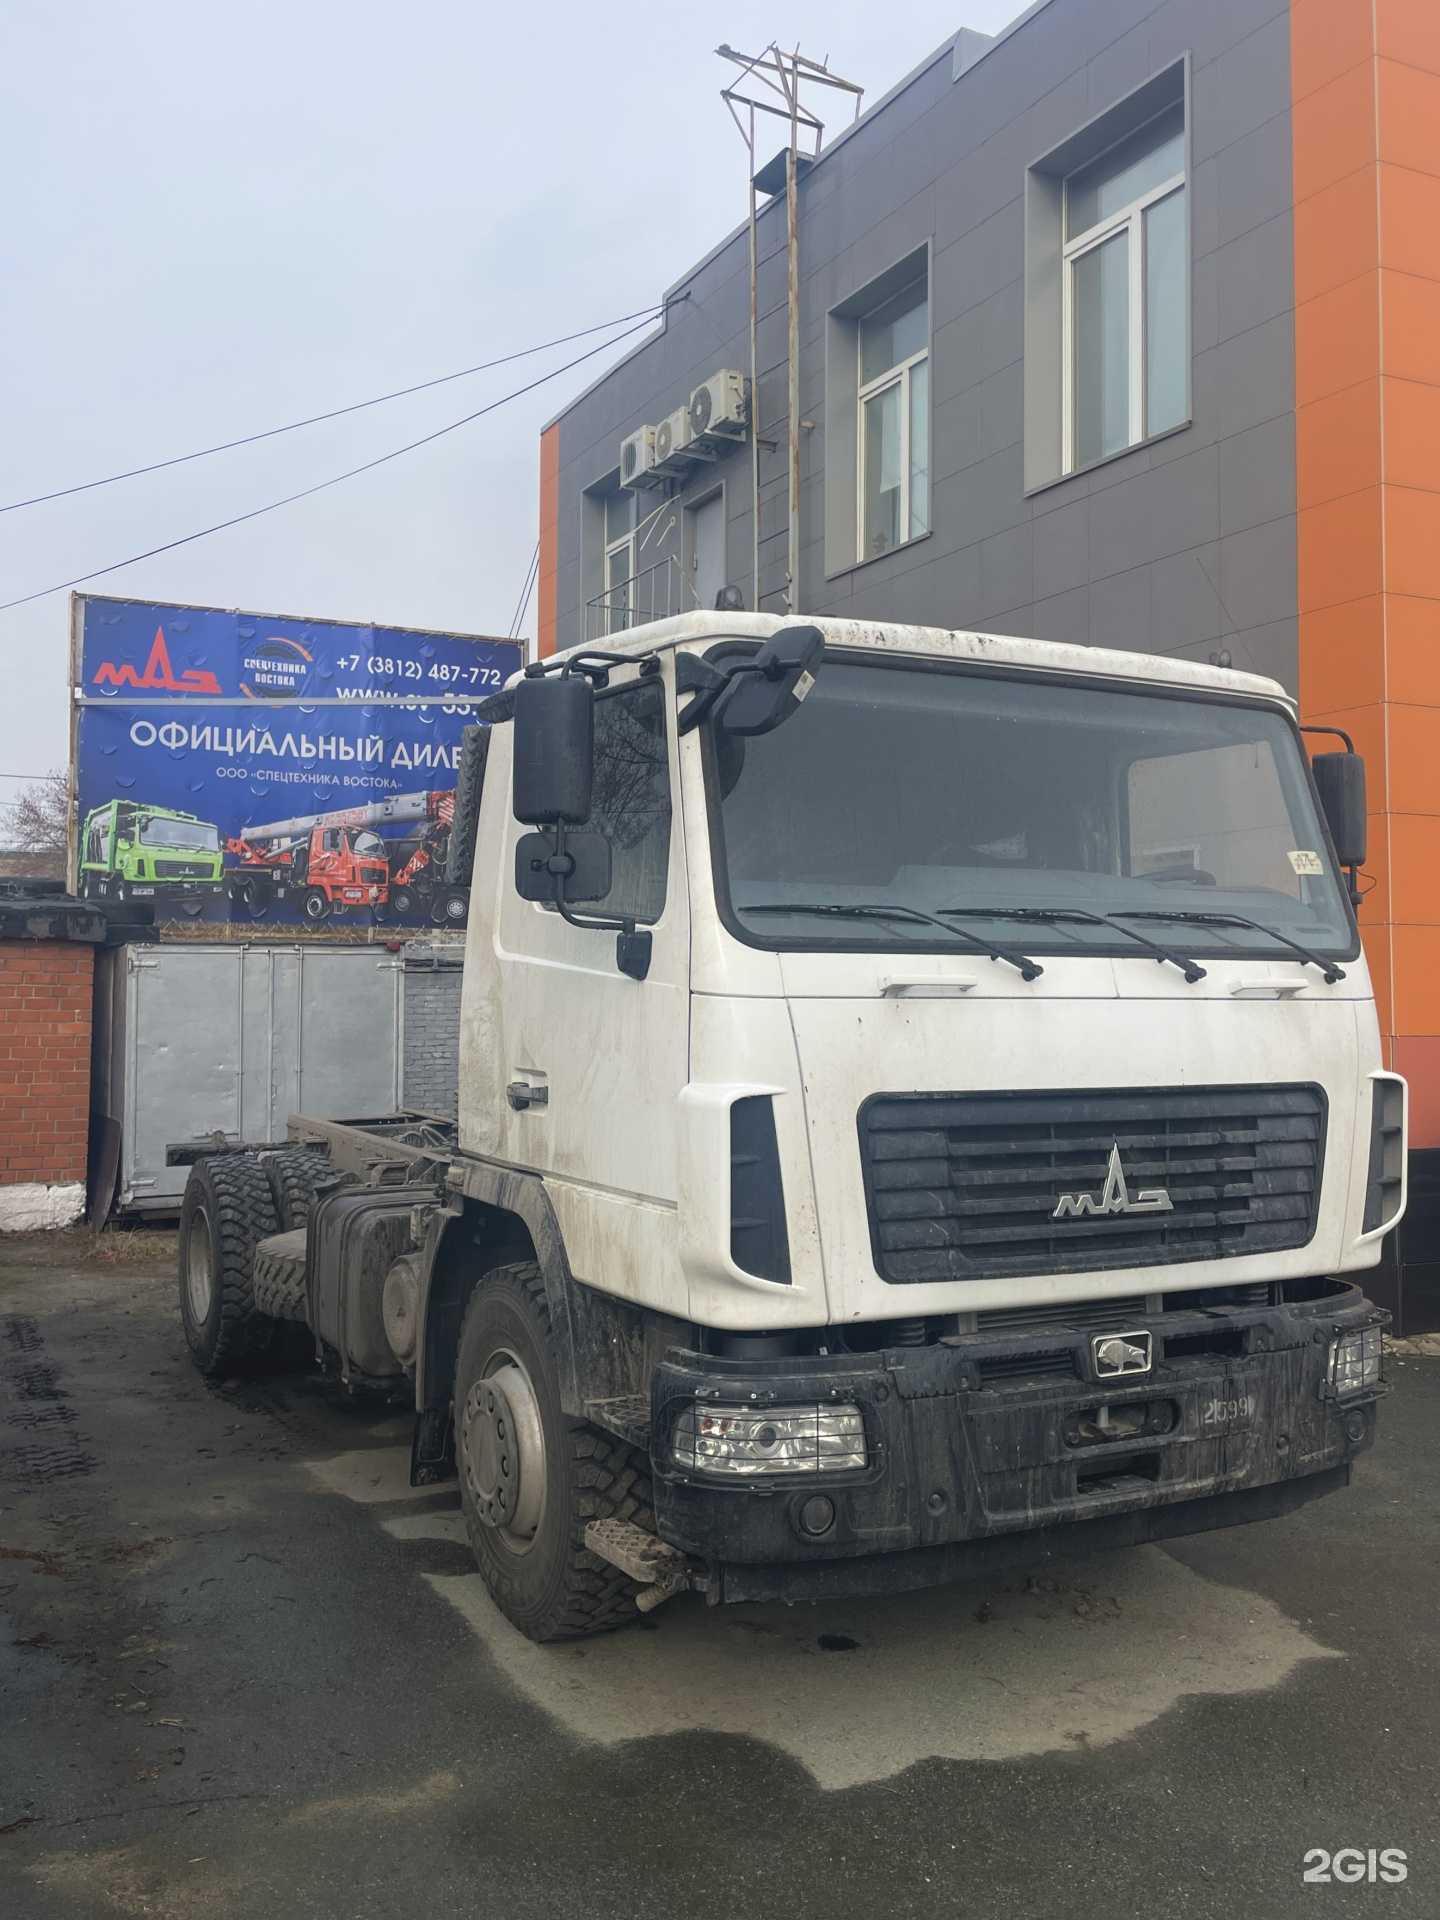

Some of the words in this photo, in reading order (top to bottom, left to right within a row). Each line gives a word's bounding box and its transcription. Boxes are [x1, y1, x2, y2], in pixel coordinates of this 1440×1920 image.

[336, 655, 360, 671] +7
[367, 656, 422, 680] (3812)
[428, 664, 501, 685] 487-772
[130, 720, 384, 763] ОФИЦИАЛЬНЫЙ
[216, 767, 248, 779] ООО
